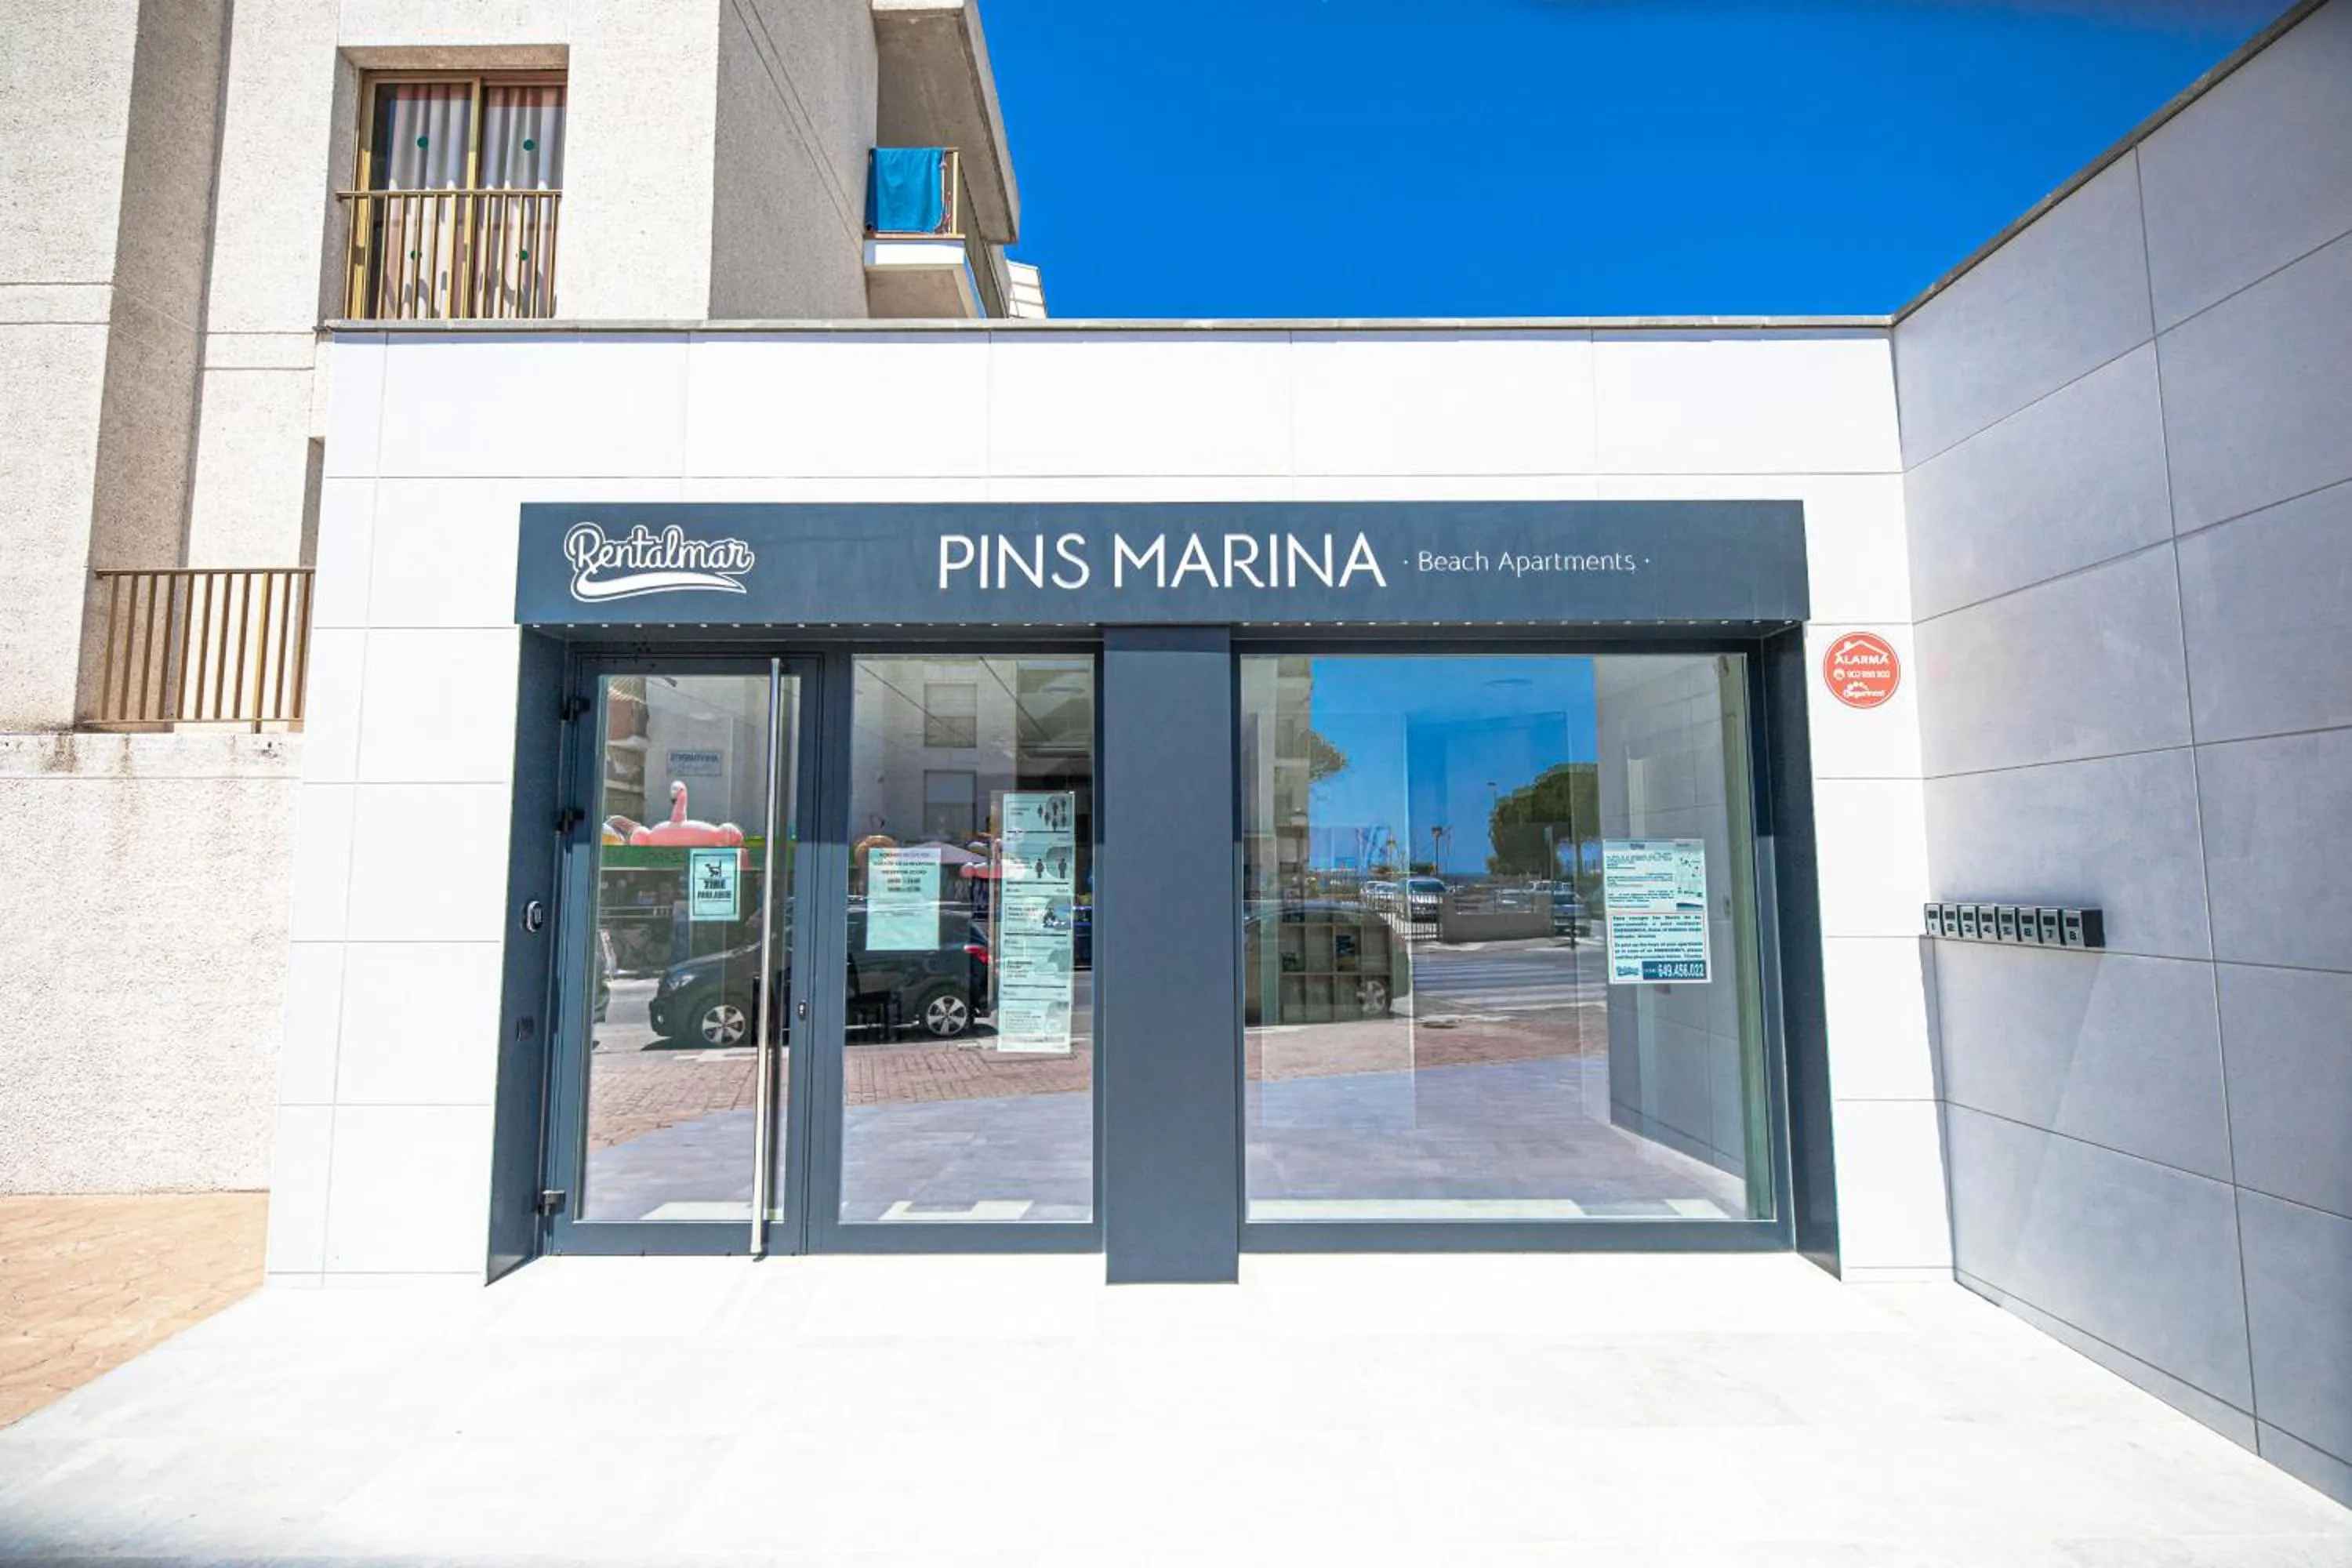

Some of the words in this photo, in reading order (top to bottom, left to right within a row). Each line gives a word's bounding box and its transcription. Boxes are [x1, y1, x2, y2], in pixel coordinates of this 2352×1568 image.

[564, 522, 753, 575] Rentalmar
[938, 532, 1091, 590] PINS
[1113, 532, 1388, 589] MARINA
[1417, 550, 1489, 572] Beach
[1498, 550, 1636, 577] Apartments
[1835, 654, 1889, 665] ALARMA
[2045, 929, 2053, 938] 7
